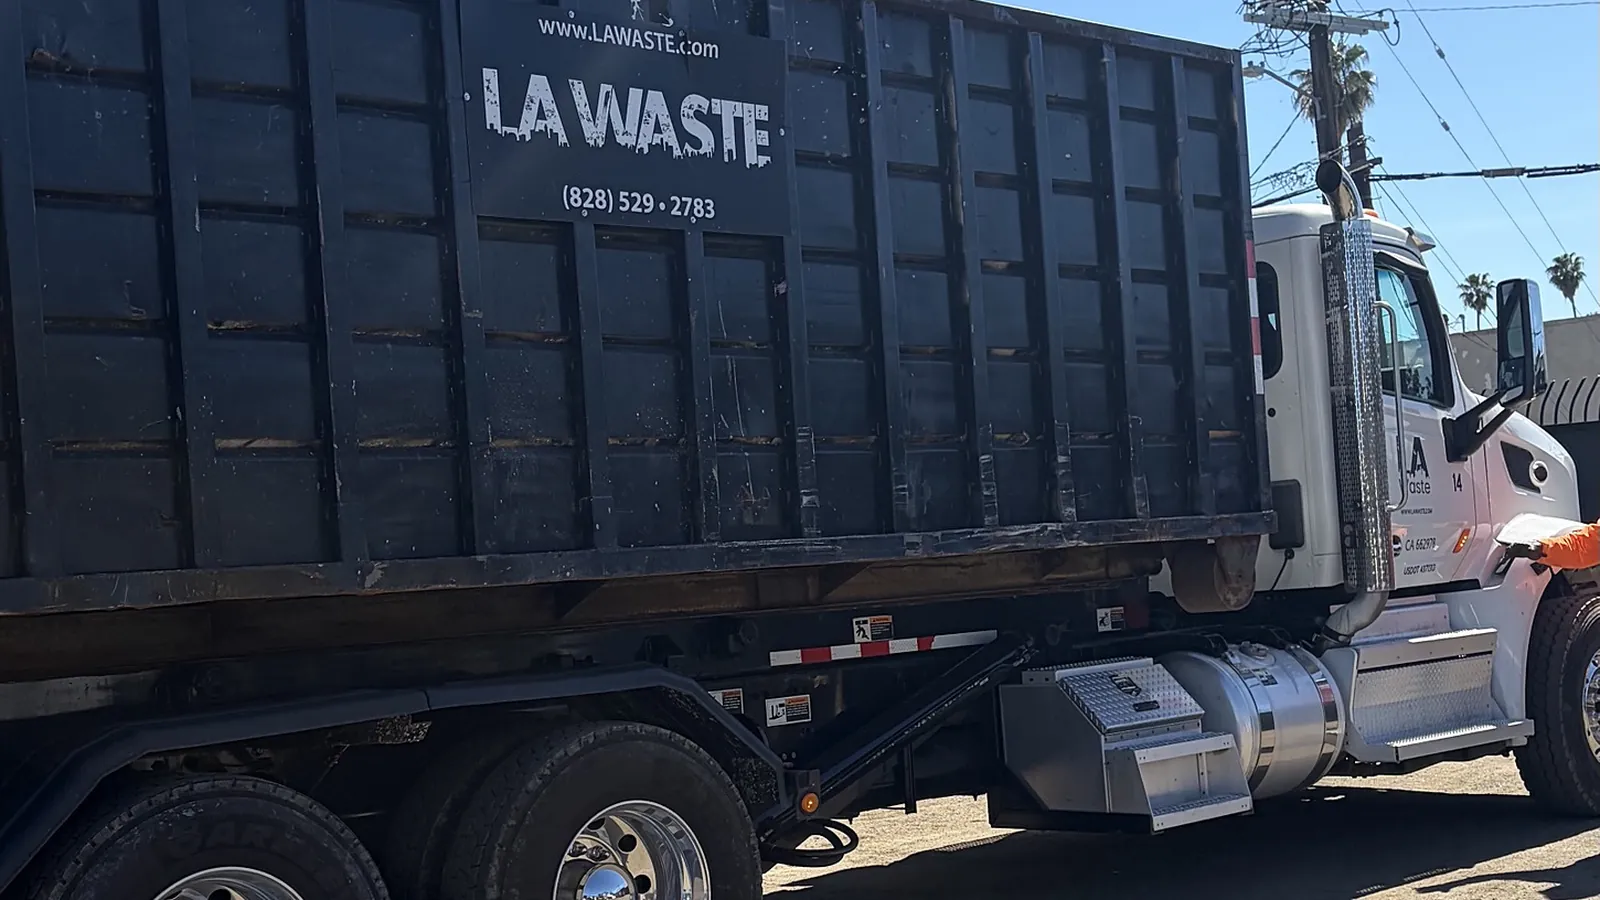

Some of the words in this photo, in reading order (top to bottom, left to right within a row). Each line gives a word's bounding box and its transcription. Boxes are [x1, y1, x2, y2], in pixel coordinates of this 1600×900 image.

[538, 17, 719, 59] www.LAWASTE.com
[482, 67, 570, 147] LA
[568, 78, 772, 169] WASTE
[562, 184, 613, 213] (828)
[619, 190, 654, 214] 529
[670, 195, 715, 219] 2783
[1452, 473, 1463, 492] 14
[1405, 539, 1415, 551] CA
